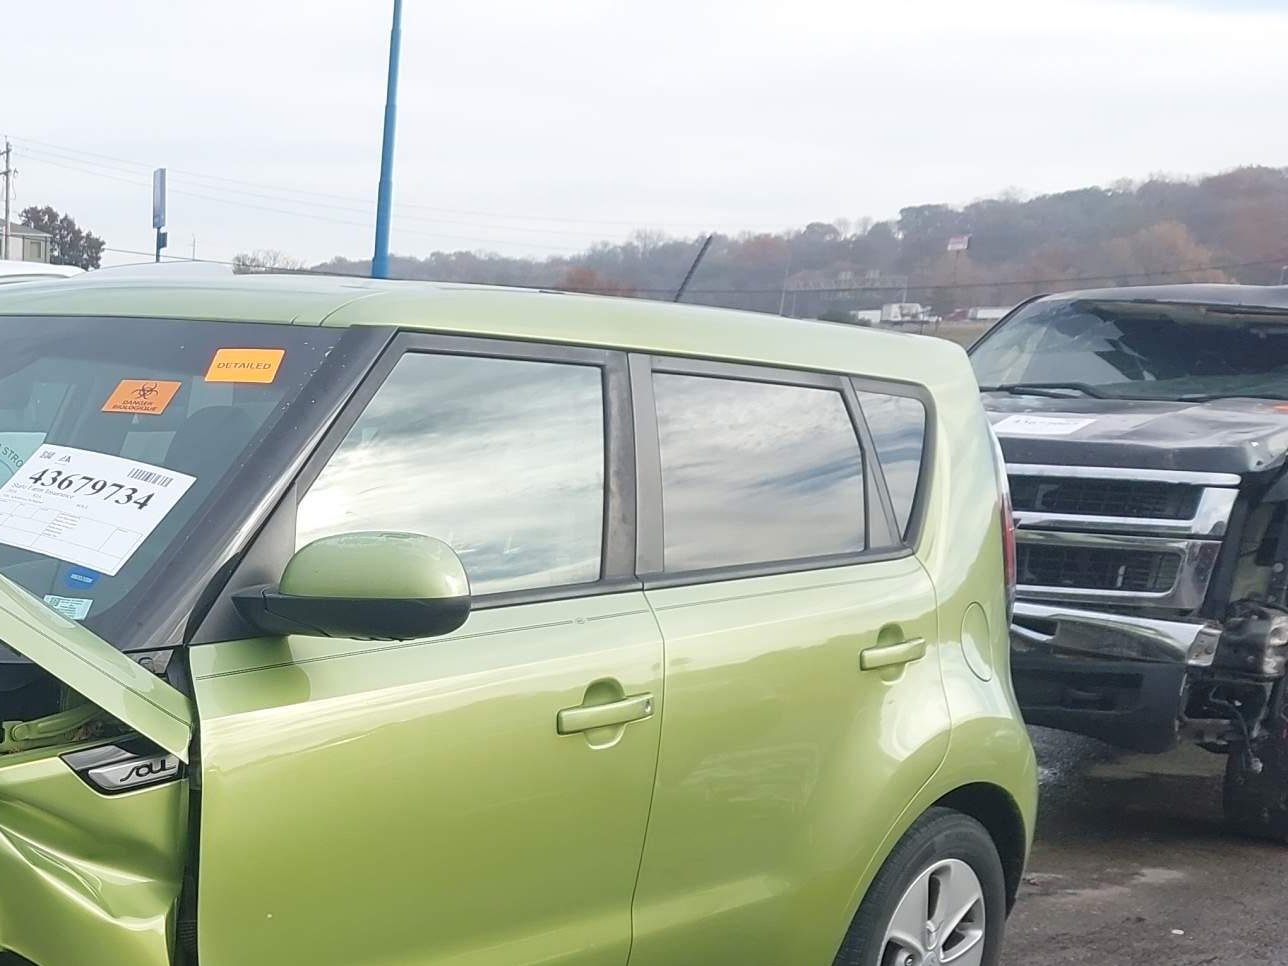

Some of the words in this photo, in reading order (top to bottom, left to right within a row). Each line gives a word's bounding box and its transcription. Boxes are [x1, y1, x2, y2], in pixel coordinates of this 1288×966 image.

[216, 361, 273, 371] DETAILED
[111, 404, 158, 412] BIOLOGIQUE
[28, 467, 156, 511] 43679734
